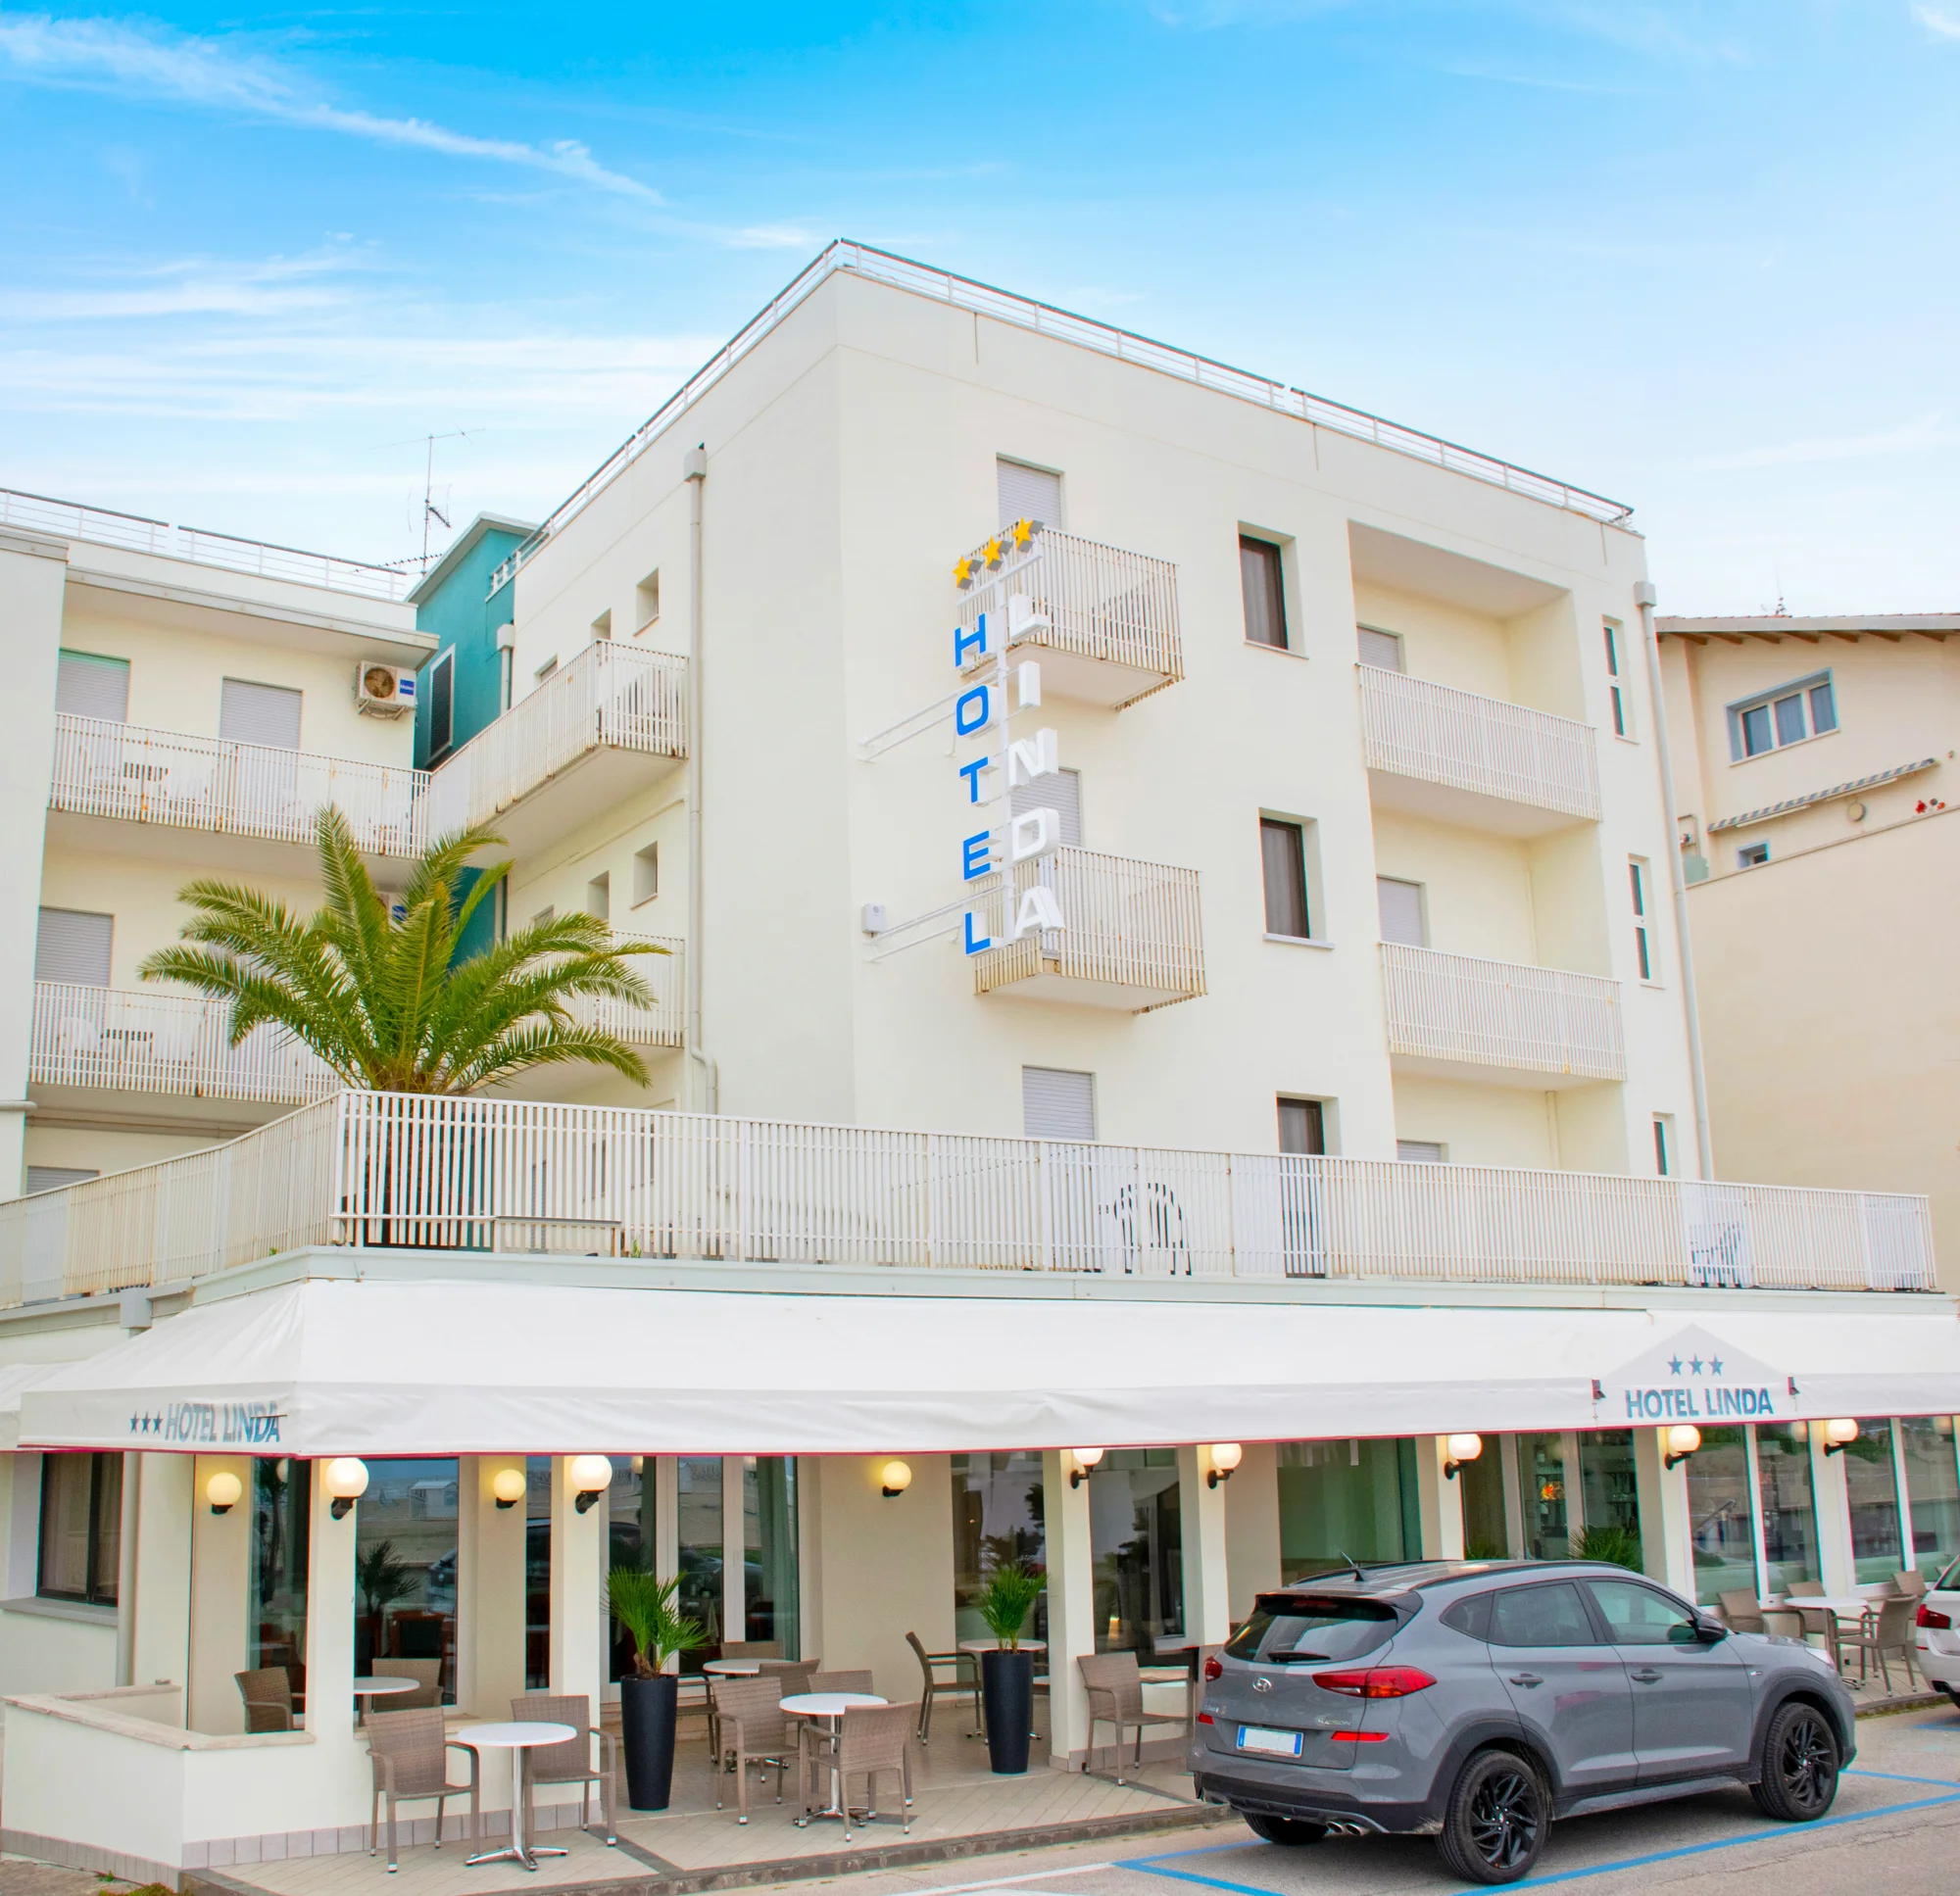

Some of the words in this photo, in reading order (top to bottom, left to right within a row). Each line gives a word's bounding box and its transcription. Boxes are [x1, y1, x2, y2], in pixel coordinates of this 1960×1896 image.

[955, 612, 993, 956] HOTEL
[1008, 592, 1065, 939] LINDA
[165, 1403, 218, 1442] HOTEL
[222, 1401, 281, 1443] LINDA
[1625, 1388, 1699, 1418] HOTEL
[1705, 1387, 1774, 1415] LINDA
